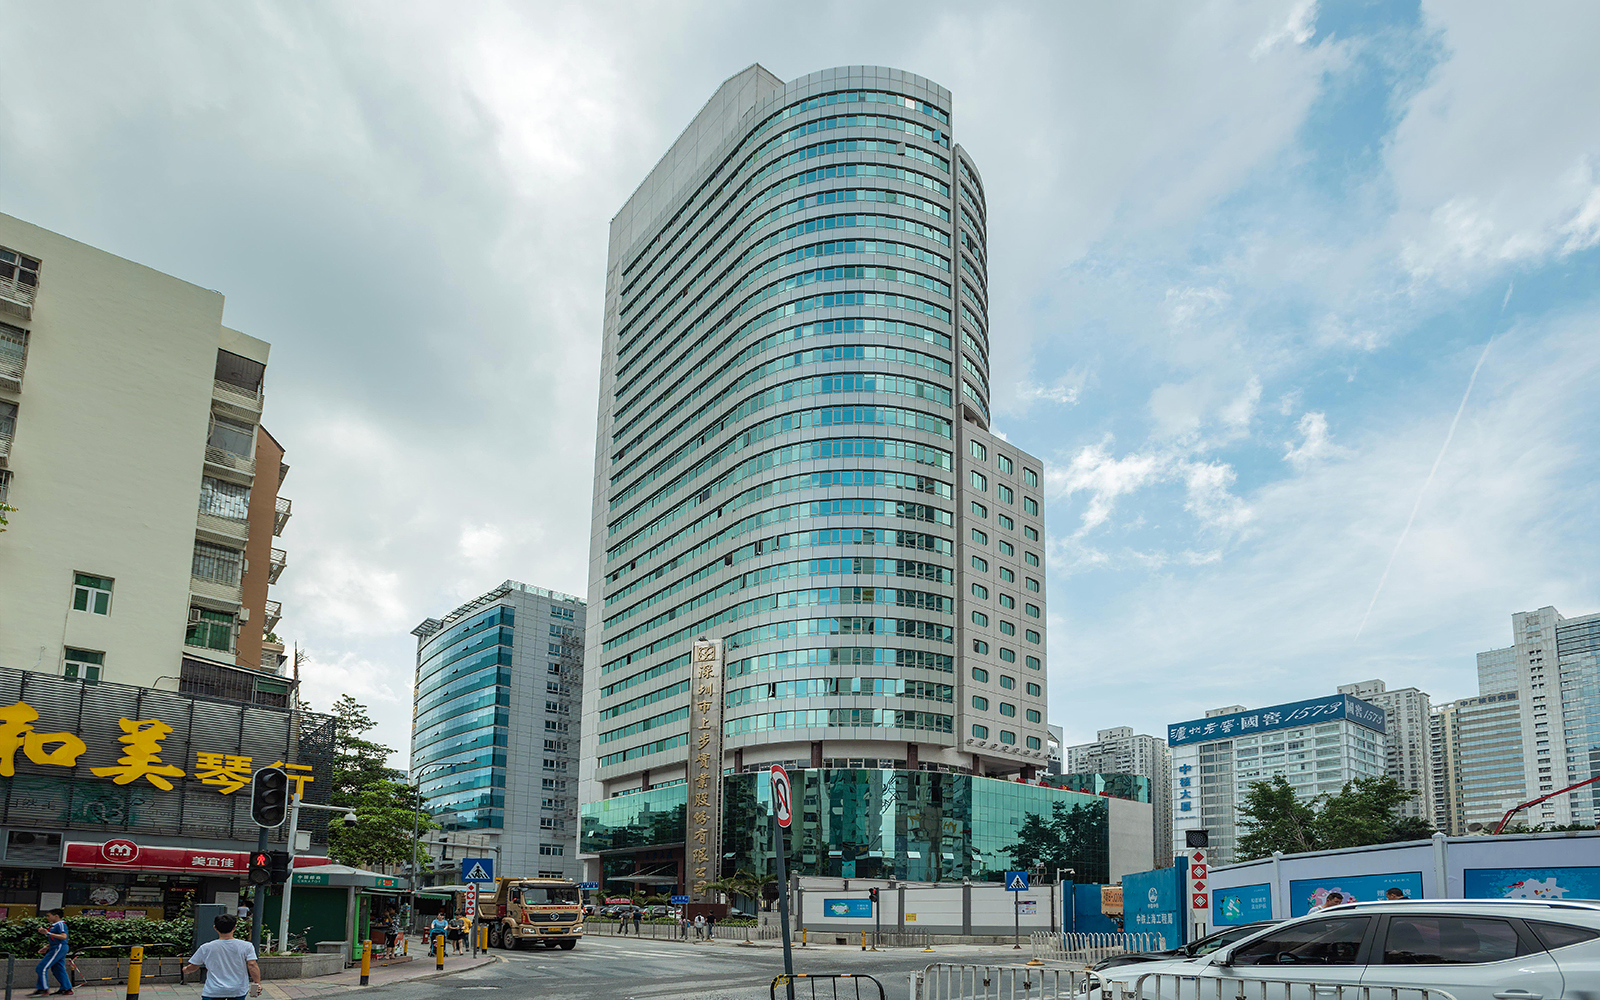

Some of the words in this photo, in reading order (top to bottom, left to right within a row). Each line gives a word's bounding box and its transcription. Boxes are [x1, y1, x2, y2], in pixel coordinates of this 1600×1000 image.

[191, 856, 235, 868] 美宜佳
[1136, 912, 1174, 925] 中铁上海工程局
